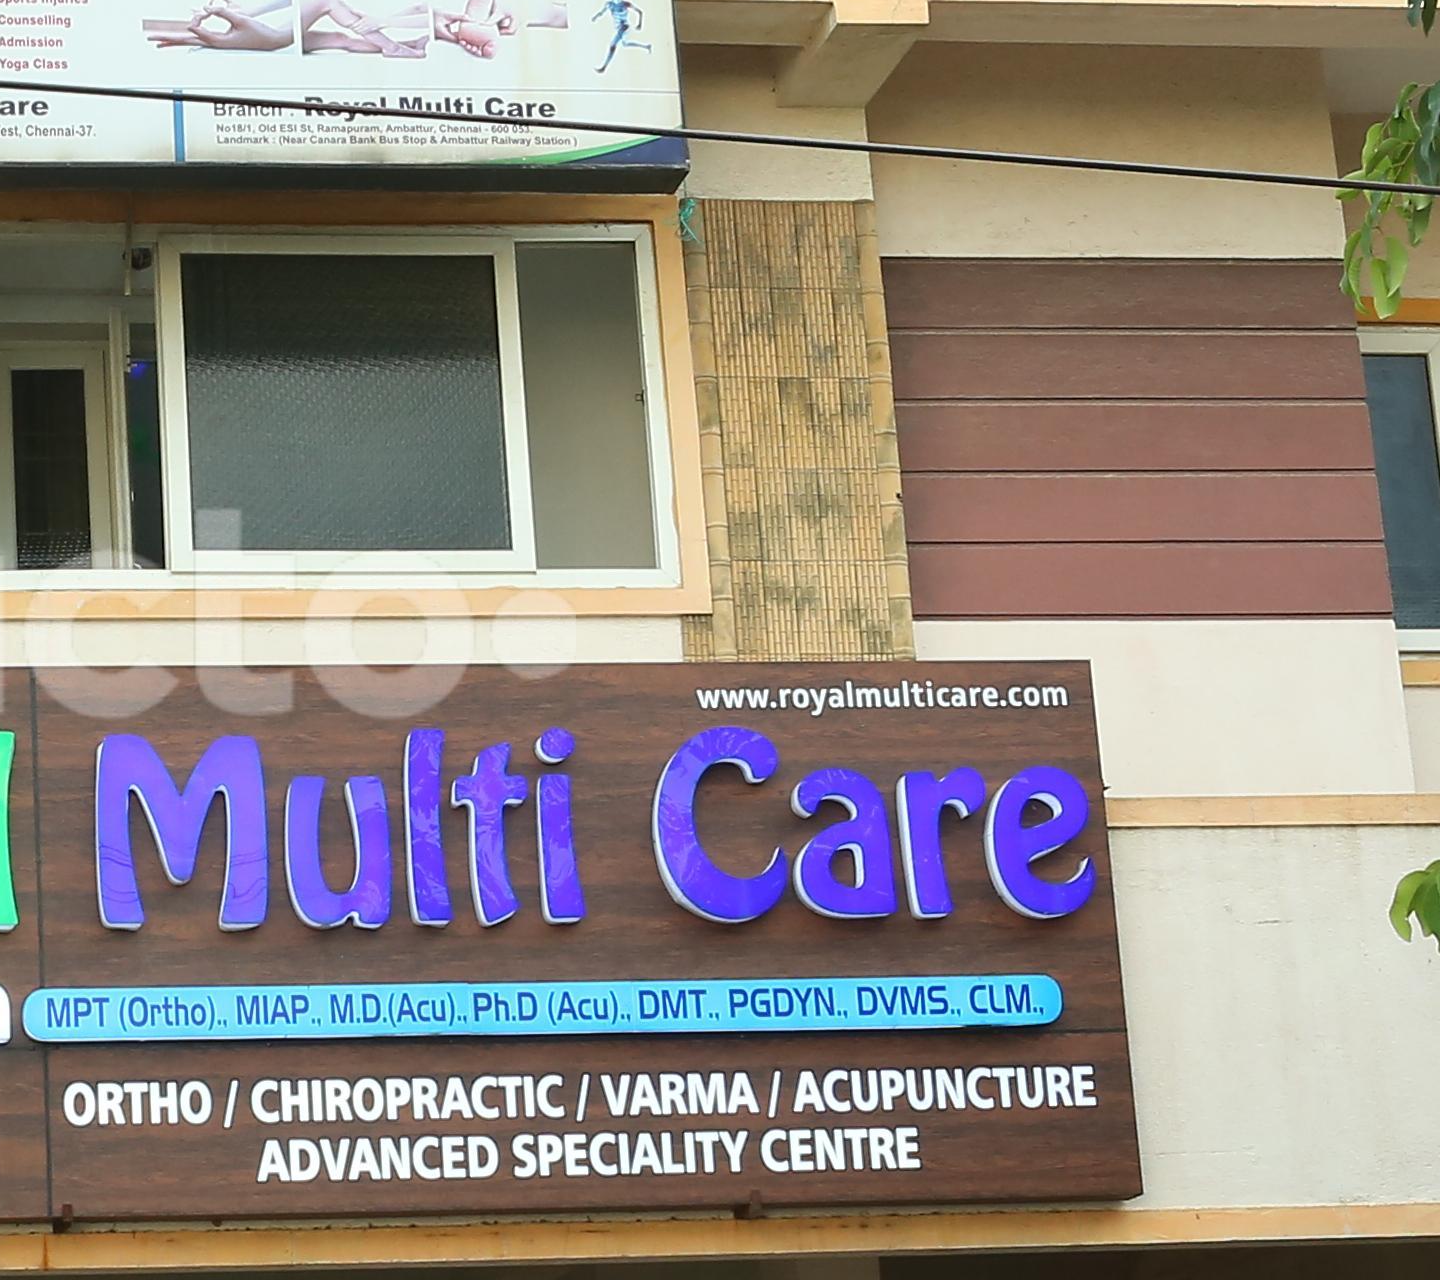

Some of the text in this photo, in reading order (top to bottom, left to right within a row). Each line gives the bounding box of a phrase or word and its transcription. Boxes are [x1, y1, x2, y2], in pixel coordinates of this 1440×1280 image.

[697, 683, 1068, 717] www.royalmulticare.com
[95, 727, 585, 930] Multi
[652, 724, 1096, 923] Care
[45, 997, 113, 1030] MPT
[473, 991, 539, 1023] Ph.D
[63, 1064, 1097, 1126] ORTHO CHIROPRACTIC VARMA ACUPUNCTURE
[256, 1126, 921, 1183] ADVANCED SPECIALITY CENTRE
